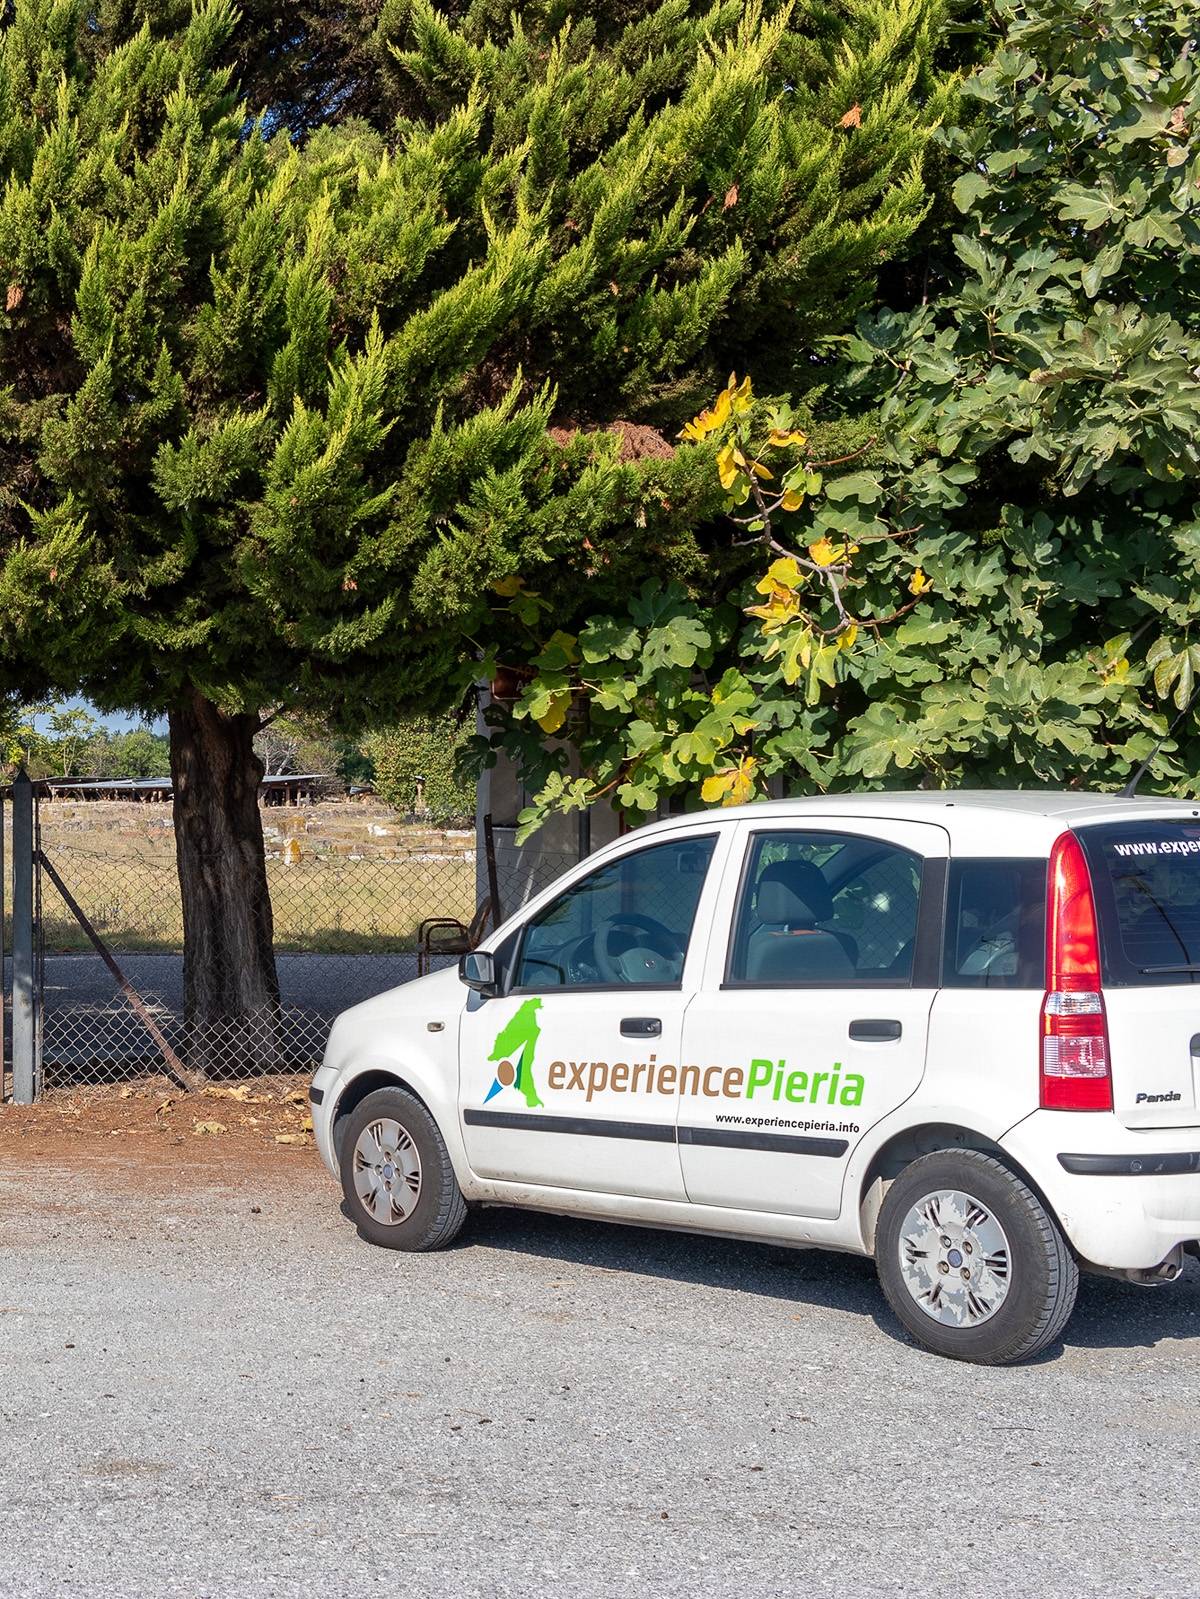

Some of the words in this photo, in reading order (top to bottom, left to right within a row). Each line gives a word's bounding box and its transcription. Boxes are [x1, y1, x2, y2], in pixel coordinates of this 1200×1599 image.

[548, 1054, 865, 1106] experiencePieria
[1135, 1090, 1181, 1104] Panda
[715, 1114, 860, 1133] www.experiencepieria.info
